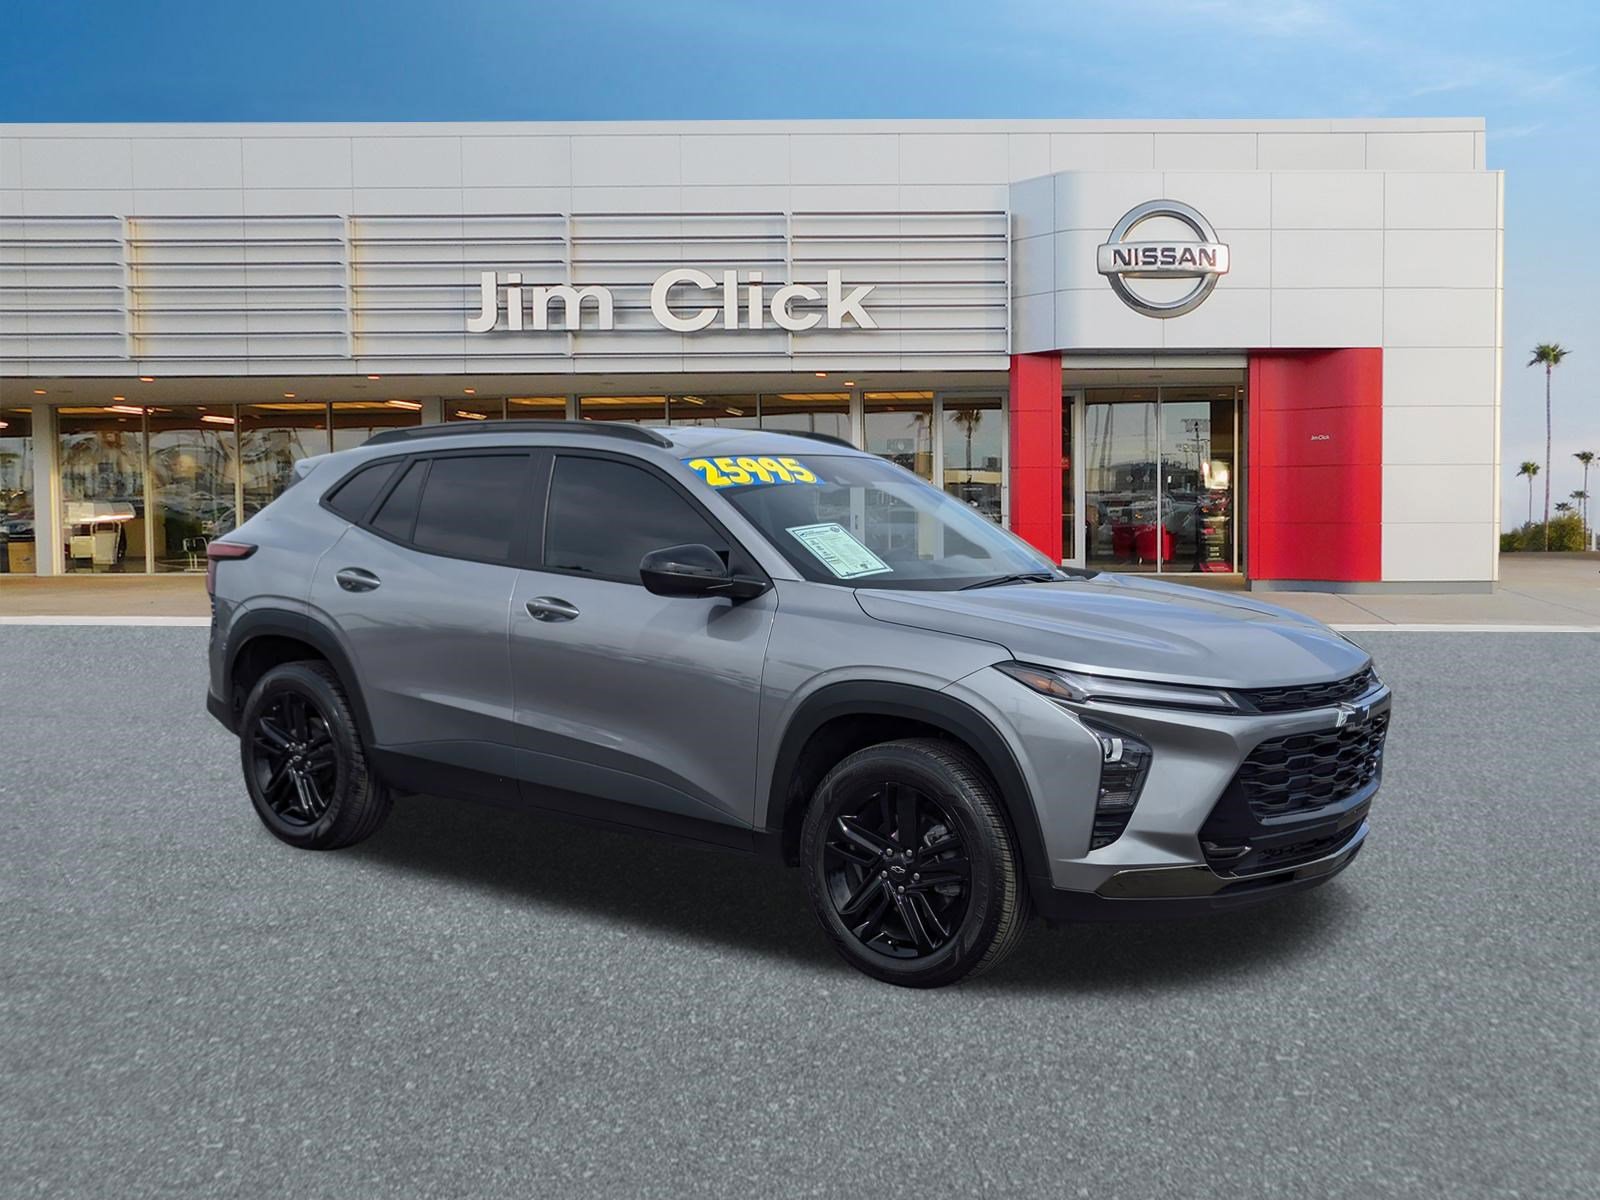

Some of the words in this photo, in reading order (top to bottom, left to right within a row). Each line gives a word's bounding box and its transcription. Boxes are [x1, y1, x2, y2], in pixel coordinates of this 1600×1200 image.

[1113, 247, 1217, 267] NISSAN
[467, 270, 614, 333] Jim
[650, 268, 879, 333] Click
[688, 456, 817, 487] 25995
